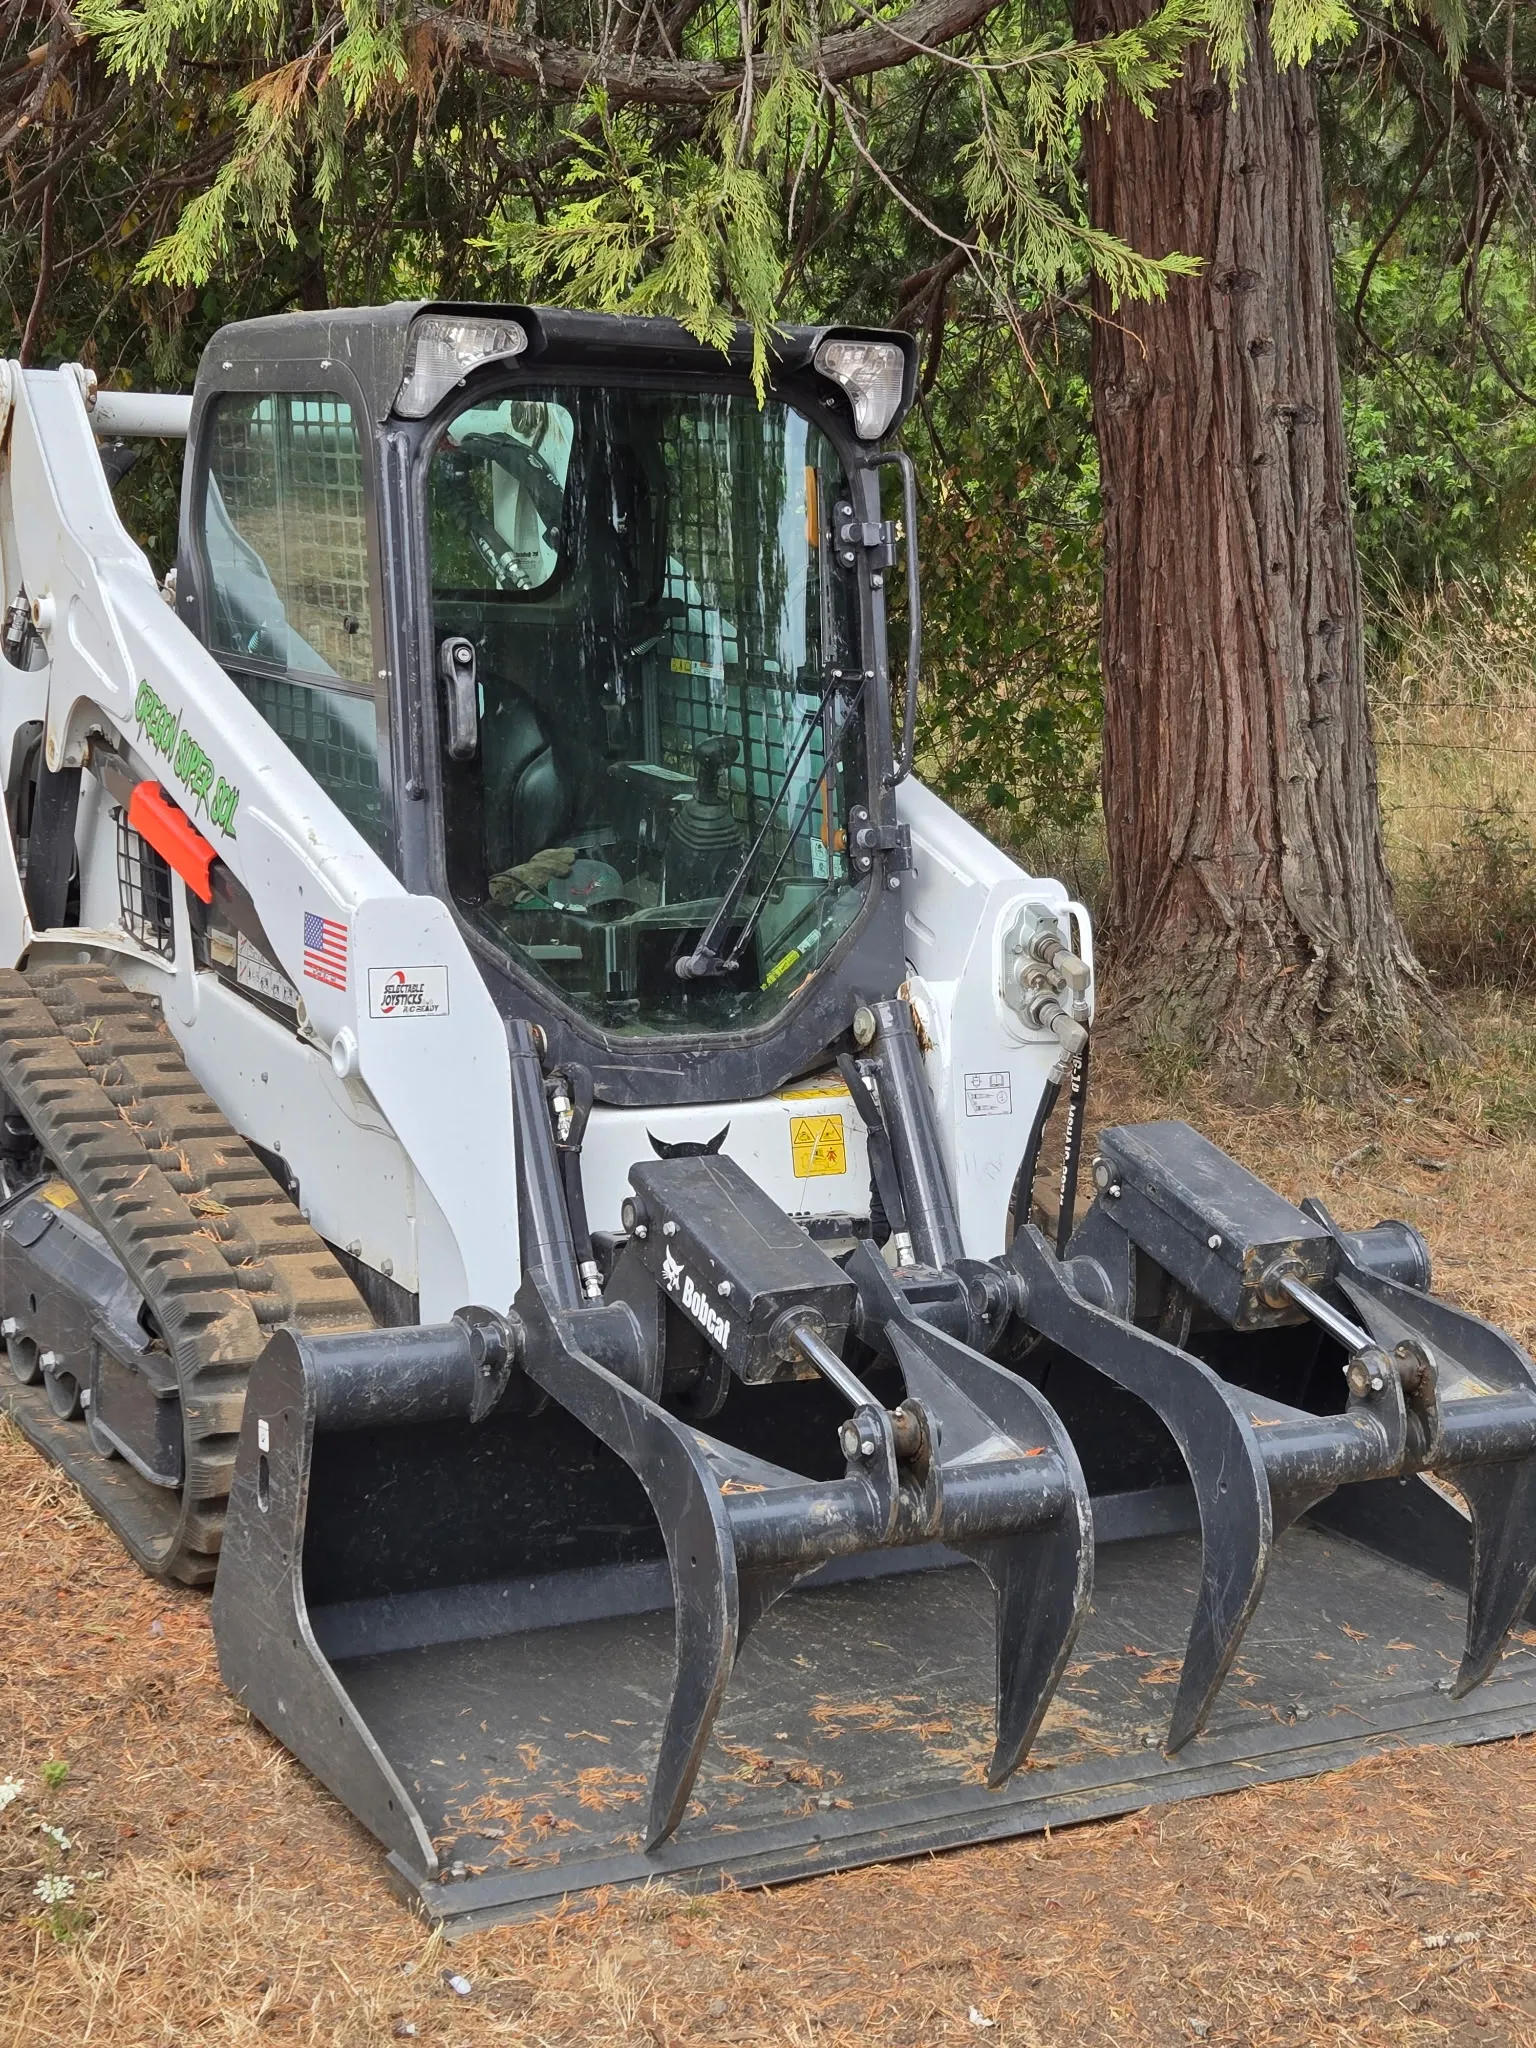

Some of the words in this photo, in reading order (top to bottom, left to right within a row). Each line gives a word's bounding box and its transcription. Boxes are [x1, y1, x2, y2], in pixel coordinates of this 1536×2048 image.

[135, 679, 183, 764] OREGON
[174, 729, 215, 821] SUPER
[210, 776, 240, 841] SOIL
[380, 994, 424, 1006] JOYSTICKS
[383, 984, 425, 994] SELECTABLE
[682, 1275, 731, 1350] Bobcat
